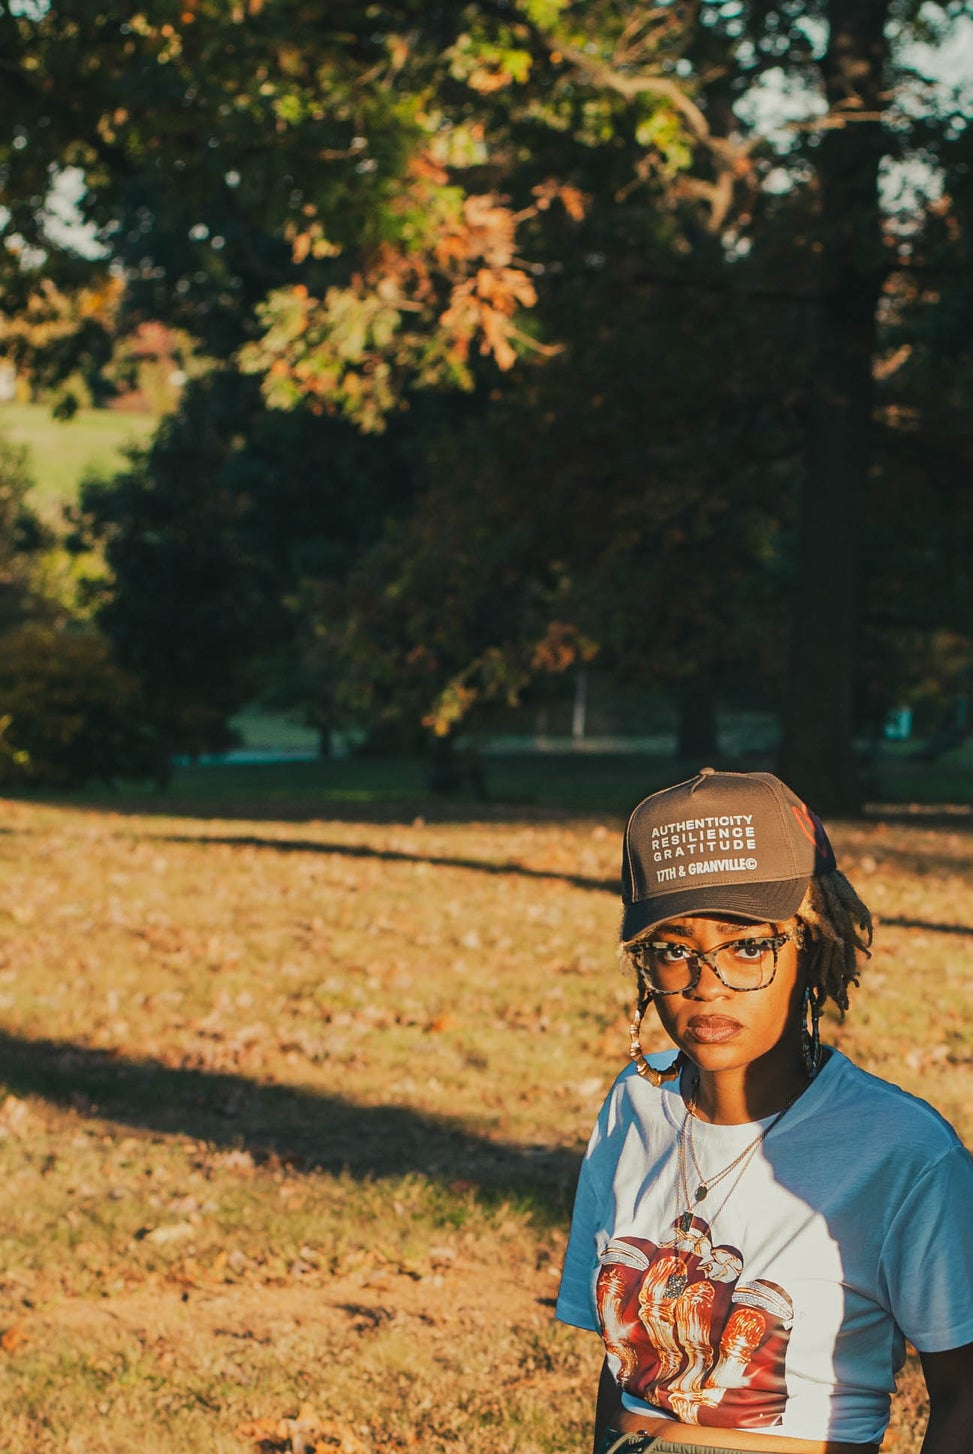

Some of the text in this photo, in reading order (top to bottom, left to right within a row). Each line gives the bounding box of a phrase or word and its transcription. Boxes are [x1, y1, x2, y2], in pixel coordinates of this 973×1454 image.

[651, 827, 756, 850] RESILIENCE
[652, 815, 753, 839] AUTHENTICITY
[653, 839, 757, 862] GRATITUDE
[656, 866, 677, 883] 17TH
[678, 865, 686, 878] &
